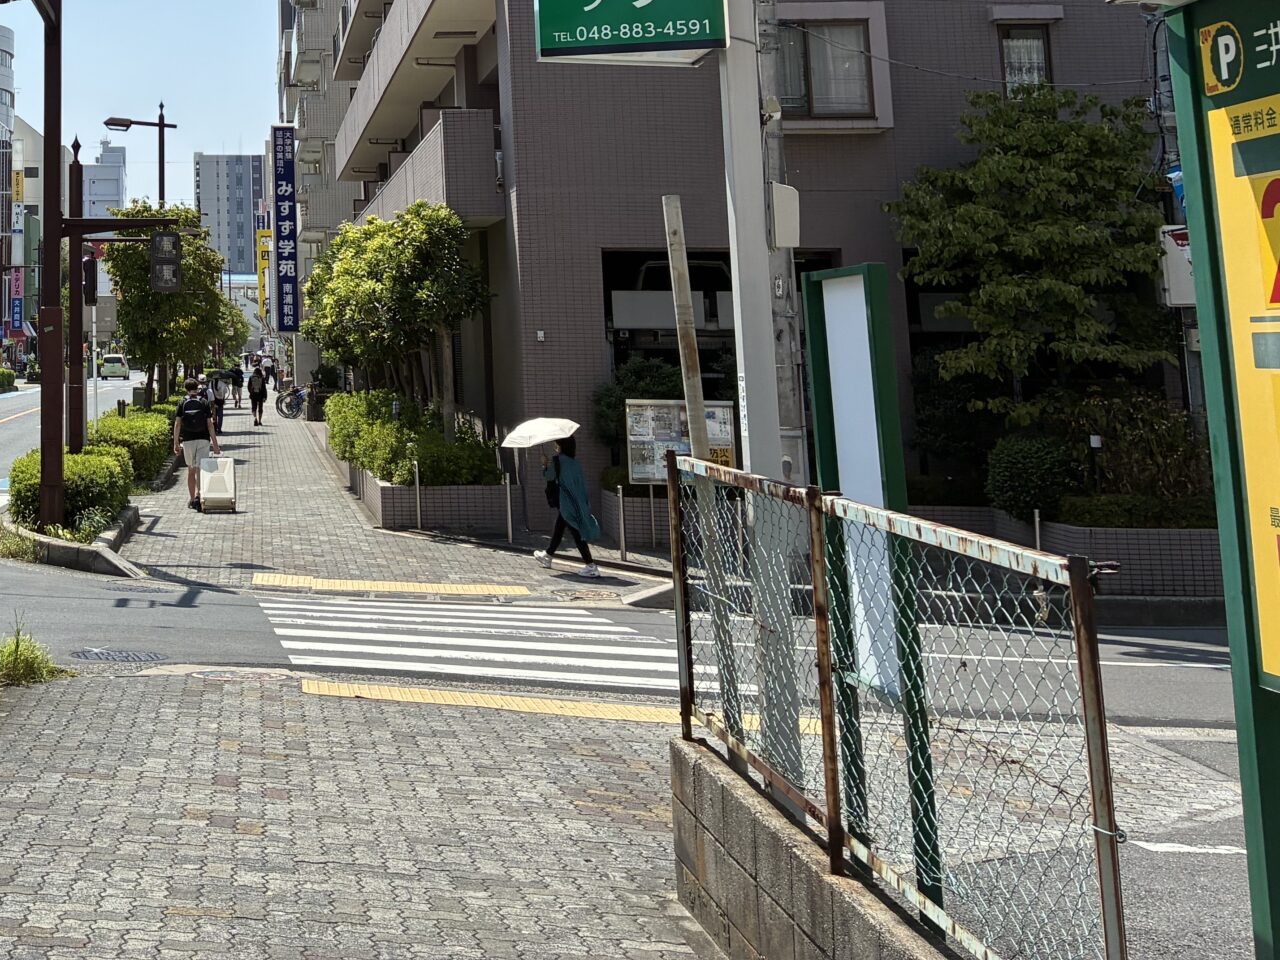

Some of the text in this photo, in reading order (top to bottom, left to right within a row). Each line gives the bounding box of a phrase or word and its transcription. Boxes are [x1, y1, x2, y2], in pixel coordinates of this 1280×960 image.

[1217, 35, 1236, 80] P
[1230, 107, 1278, 136] 通常料金
[277, 180, 297, 277] みすず学苑
[282, 283, 294, 326] 南浦和校
[709, 448, 730, 459] 防災
